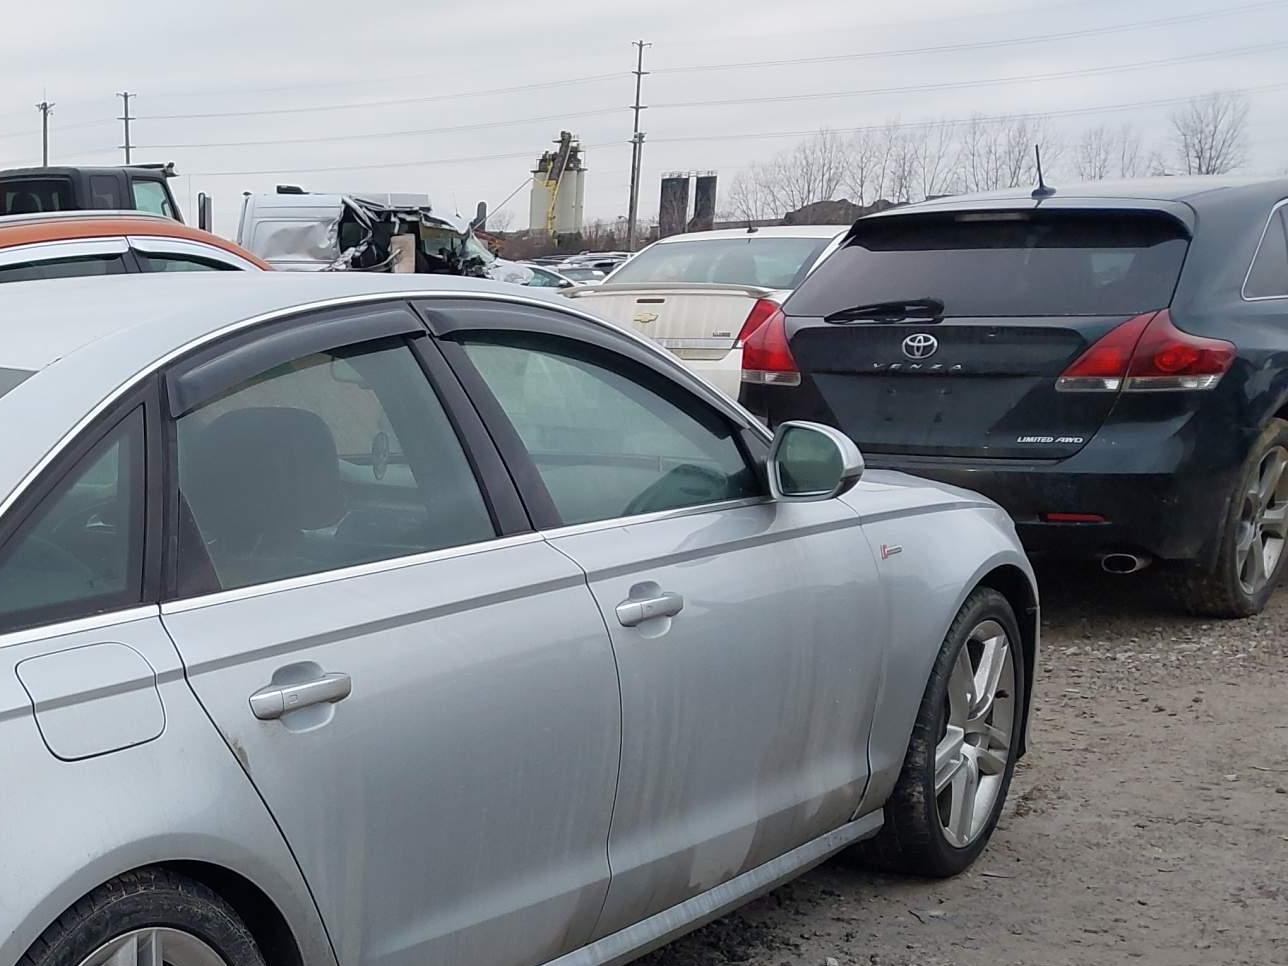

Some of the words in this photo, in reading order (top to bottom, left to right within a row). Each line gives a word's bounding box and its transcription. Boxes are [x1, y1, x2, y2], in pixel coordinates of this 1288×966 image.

[873, 362, 962, 370] VENZA
[1016, 435, 1053, 444] LIMITED
[1054, 436, 1084, 444] AWD
